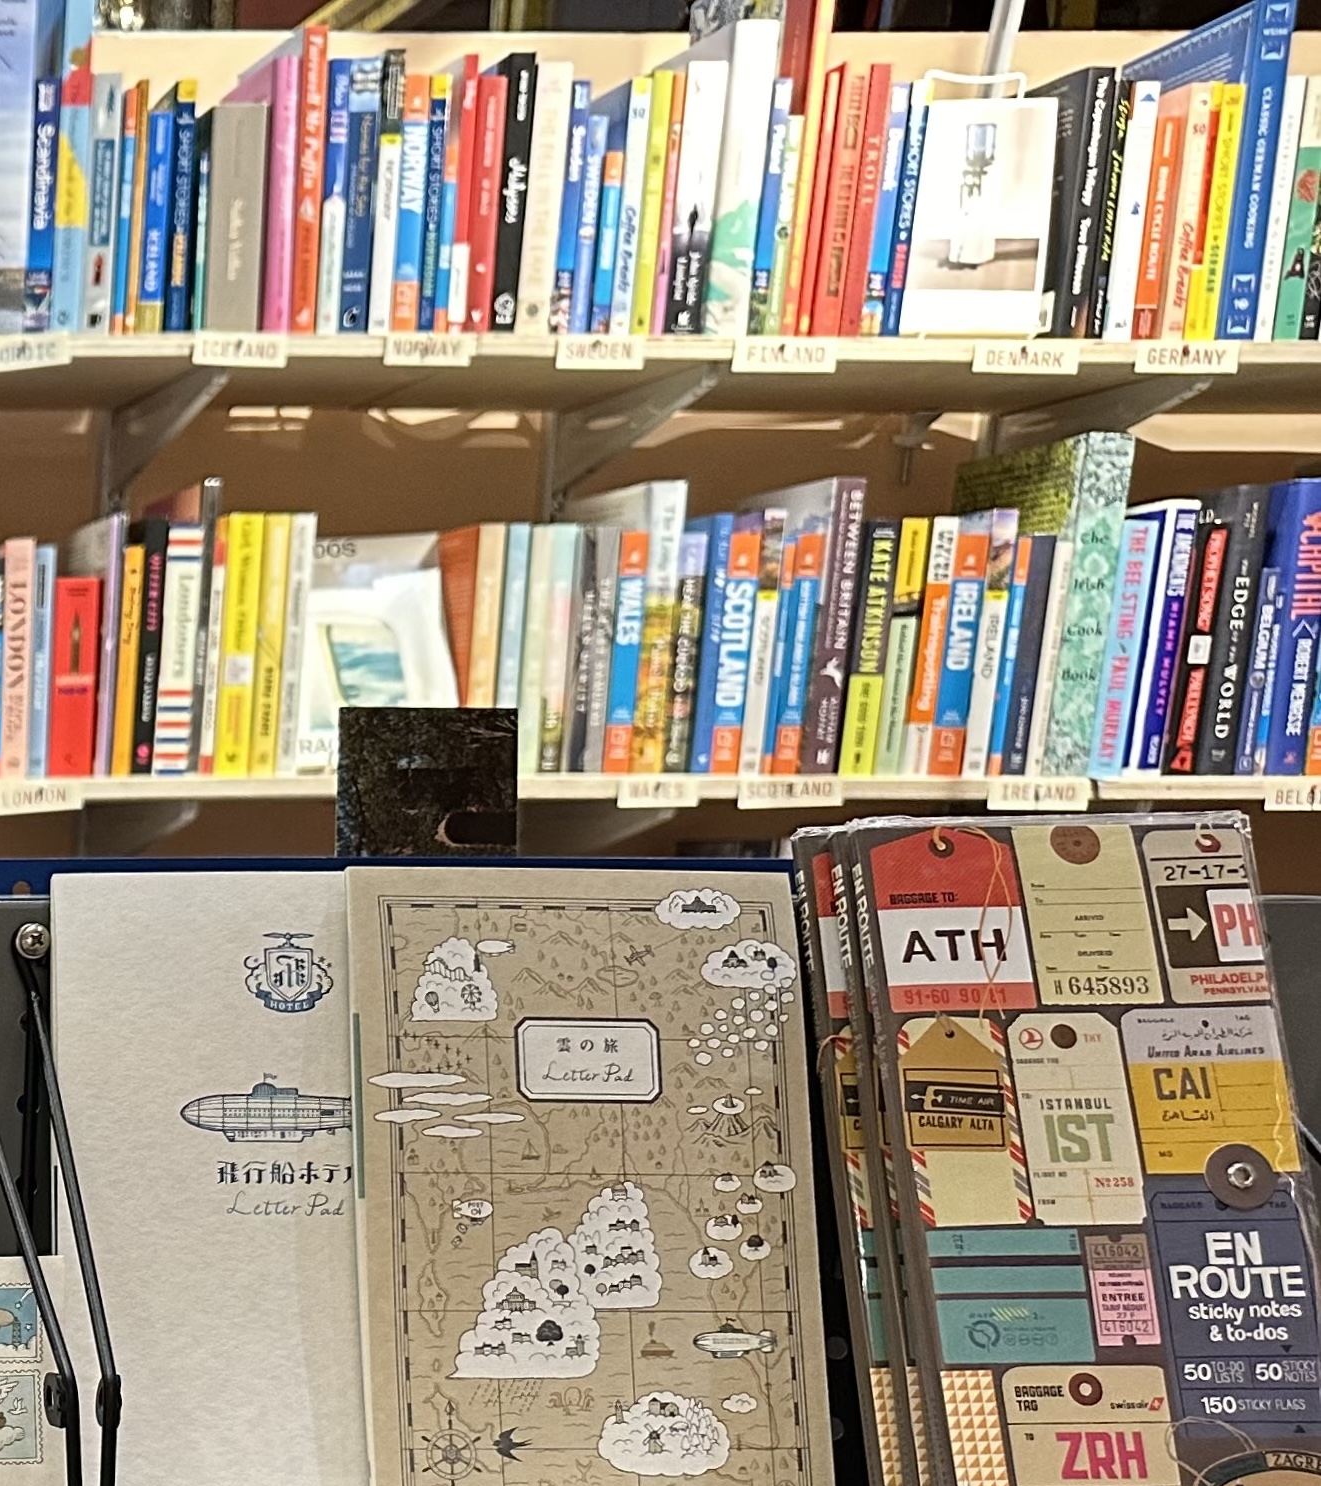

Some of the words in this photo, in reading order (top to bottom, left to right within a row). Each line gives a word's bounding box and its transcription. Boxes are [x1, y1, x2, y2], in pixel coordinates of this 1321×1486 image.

[565, 342, 633, 359] SWEDEN
[986, 350, 1063, 368] DENMARK
[1146, 347, 1226, 366] GERMANY
[1131, 526, 1149, 554] THE
[869, 538, 892, 582] KATE
[1125, 559, 1144, 586] BEE
[616, 578, 645, 646] WALES
[1115, 591, 1138, 641] STING
[1229, 576, 1251, 632] EDGE
[859, 590, 888, 674] ATKINSON
[946, 581, 980, 671] IRELAND
[715, 580, 755, 708] SCOTLAND
[1214, 663, 1239, 739] WORLD
[901, 927, 1008, 964] ATH
[1068, 975, 1150, 996] 645893
[266, 999, 310, 1012] HOTEL
[556, 1037, 621, 1054] 雲の旅
[541, 1063, 601, 1084] Letter
[603, 1062, 634, 1084] Pad
[1039, 1097, 1112, 1111] ISTANBUL
[1152, 1073, 1212, 1108] CAI
[918, 1115, 964, 1130] CALGARY
[969, 1117, 995, 1131] ALTA
[1043, 1113, 1114, 1164] IST
[226, 1190, 299, 1218] Letter
[306, 1192, 346, 1218] Pad
[1204, 1230, 1263, 1266] EN
[1168, 1264, 1306, 1300] ROUTE
[1187, 1302, 1244, 1325] sticky
[1249, 1301, 1302, 1317] notes
[1208, 1324, 1223, 1342] &
[1225, 1323, 1288, 1341] to-dos
[1182, 1363, 1211, 1380] 50
[1254, 1363, 1282, 1380] 50
[1014, 1384, 1065, 1398] BAGGAGE
[1016, 1399, 1038, 1412] TAG
[1055, 1430, 1149, 1480] ZRH
